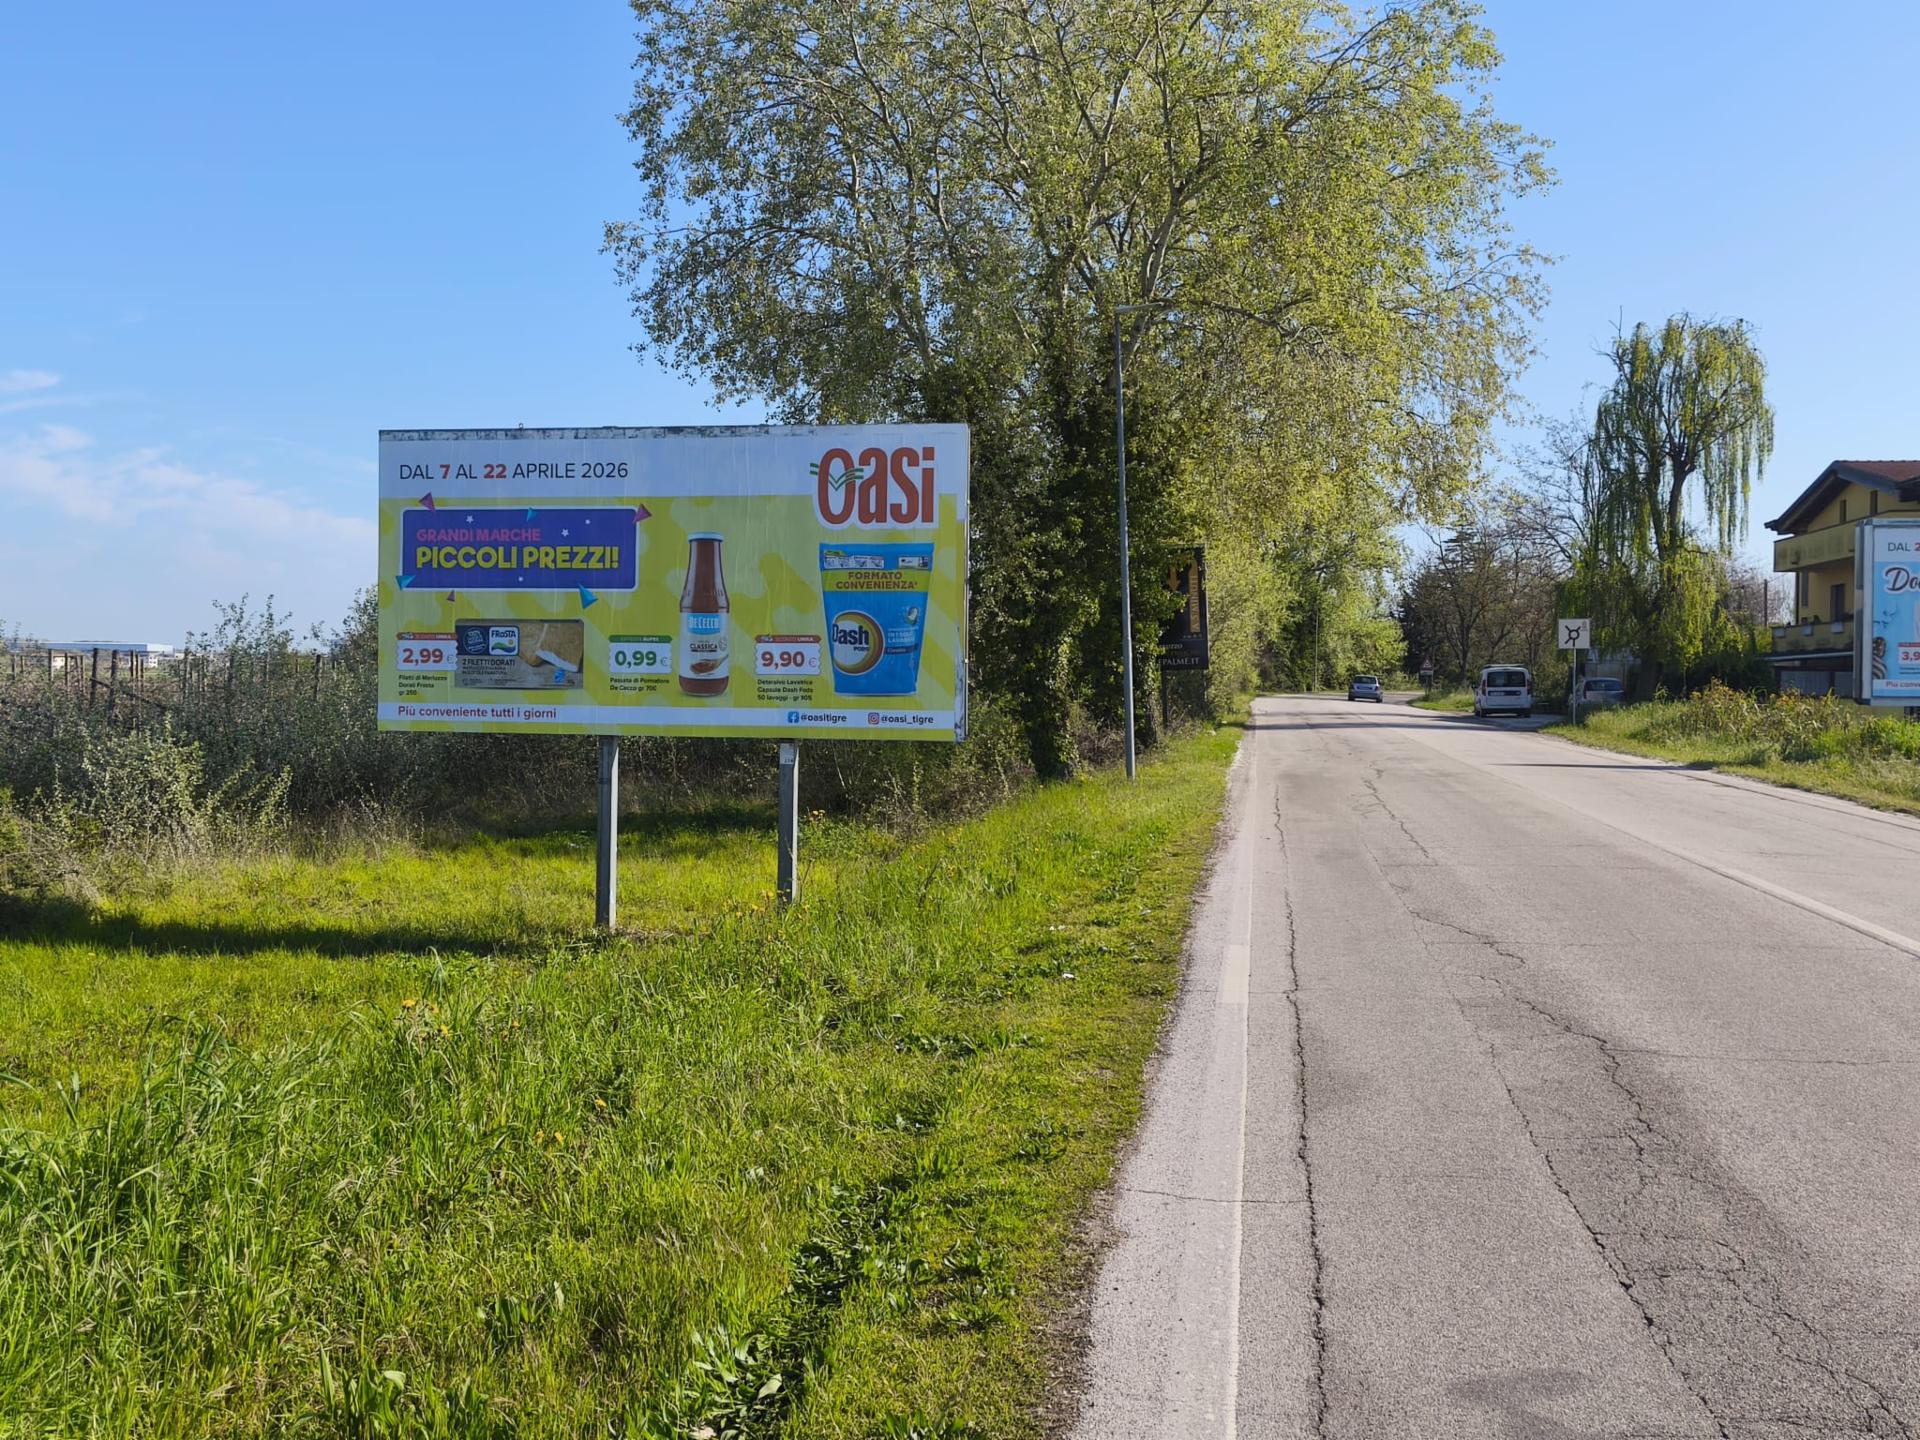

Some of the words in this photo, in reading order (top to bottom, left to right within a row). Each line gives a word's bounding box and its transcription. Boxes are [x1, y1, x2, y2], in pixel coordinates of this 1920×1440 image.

[400, 464, 434, 480] DAL
[439, 463, 451, 480] 7
[456, 463, 478, 480] AL
[483, 463, 507, 480] 22
[512, 463, 576, 479] APRILE
[581, 462, 629, 479] 2026
[416, 528, 473, 542] GRANDI
[476, 528, 542, 542] MARCHE
[1887, 542, 1911, 552] DAL
[416, 546, 518, 569] PICCOLI
[522, 546, 620, 569] PREZZI!
[848, 571, 903, 580] FORMATO
[1885, 567, 1920, 591] Do
[832, 623, 870, 646] Dash
[402, 648, 444, 666] 2,99
[490, 659, 516, 667] DORATI
[614, 650, 657, 668] 0,99
[660, 656, 669, 667] €
[761, 651, 805, 670] 9,90
[808, 657, 817, 668] €
[398, 705, 416, 716] Più
[419, 707, 488, 718] conveniente
[491, 706, 515, 718] tutti
[523, 707, 557, 720] giorni
[800, 713, 847, 724] @oasitigre
[881, 714, 934, 725] @oasi_tigre
